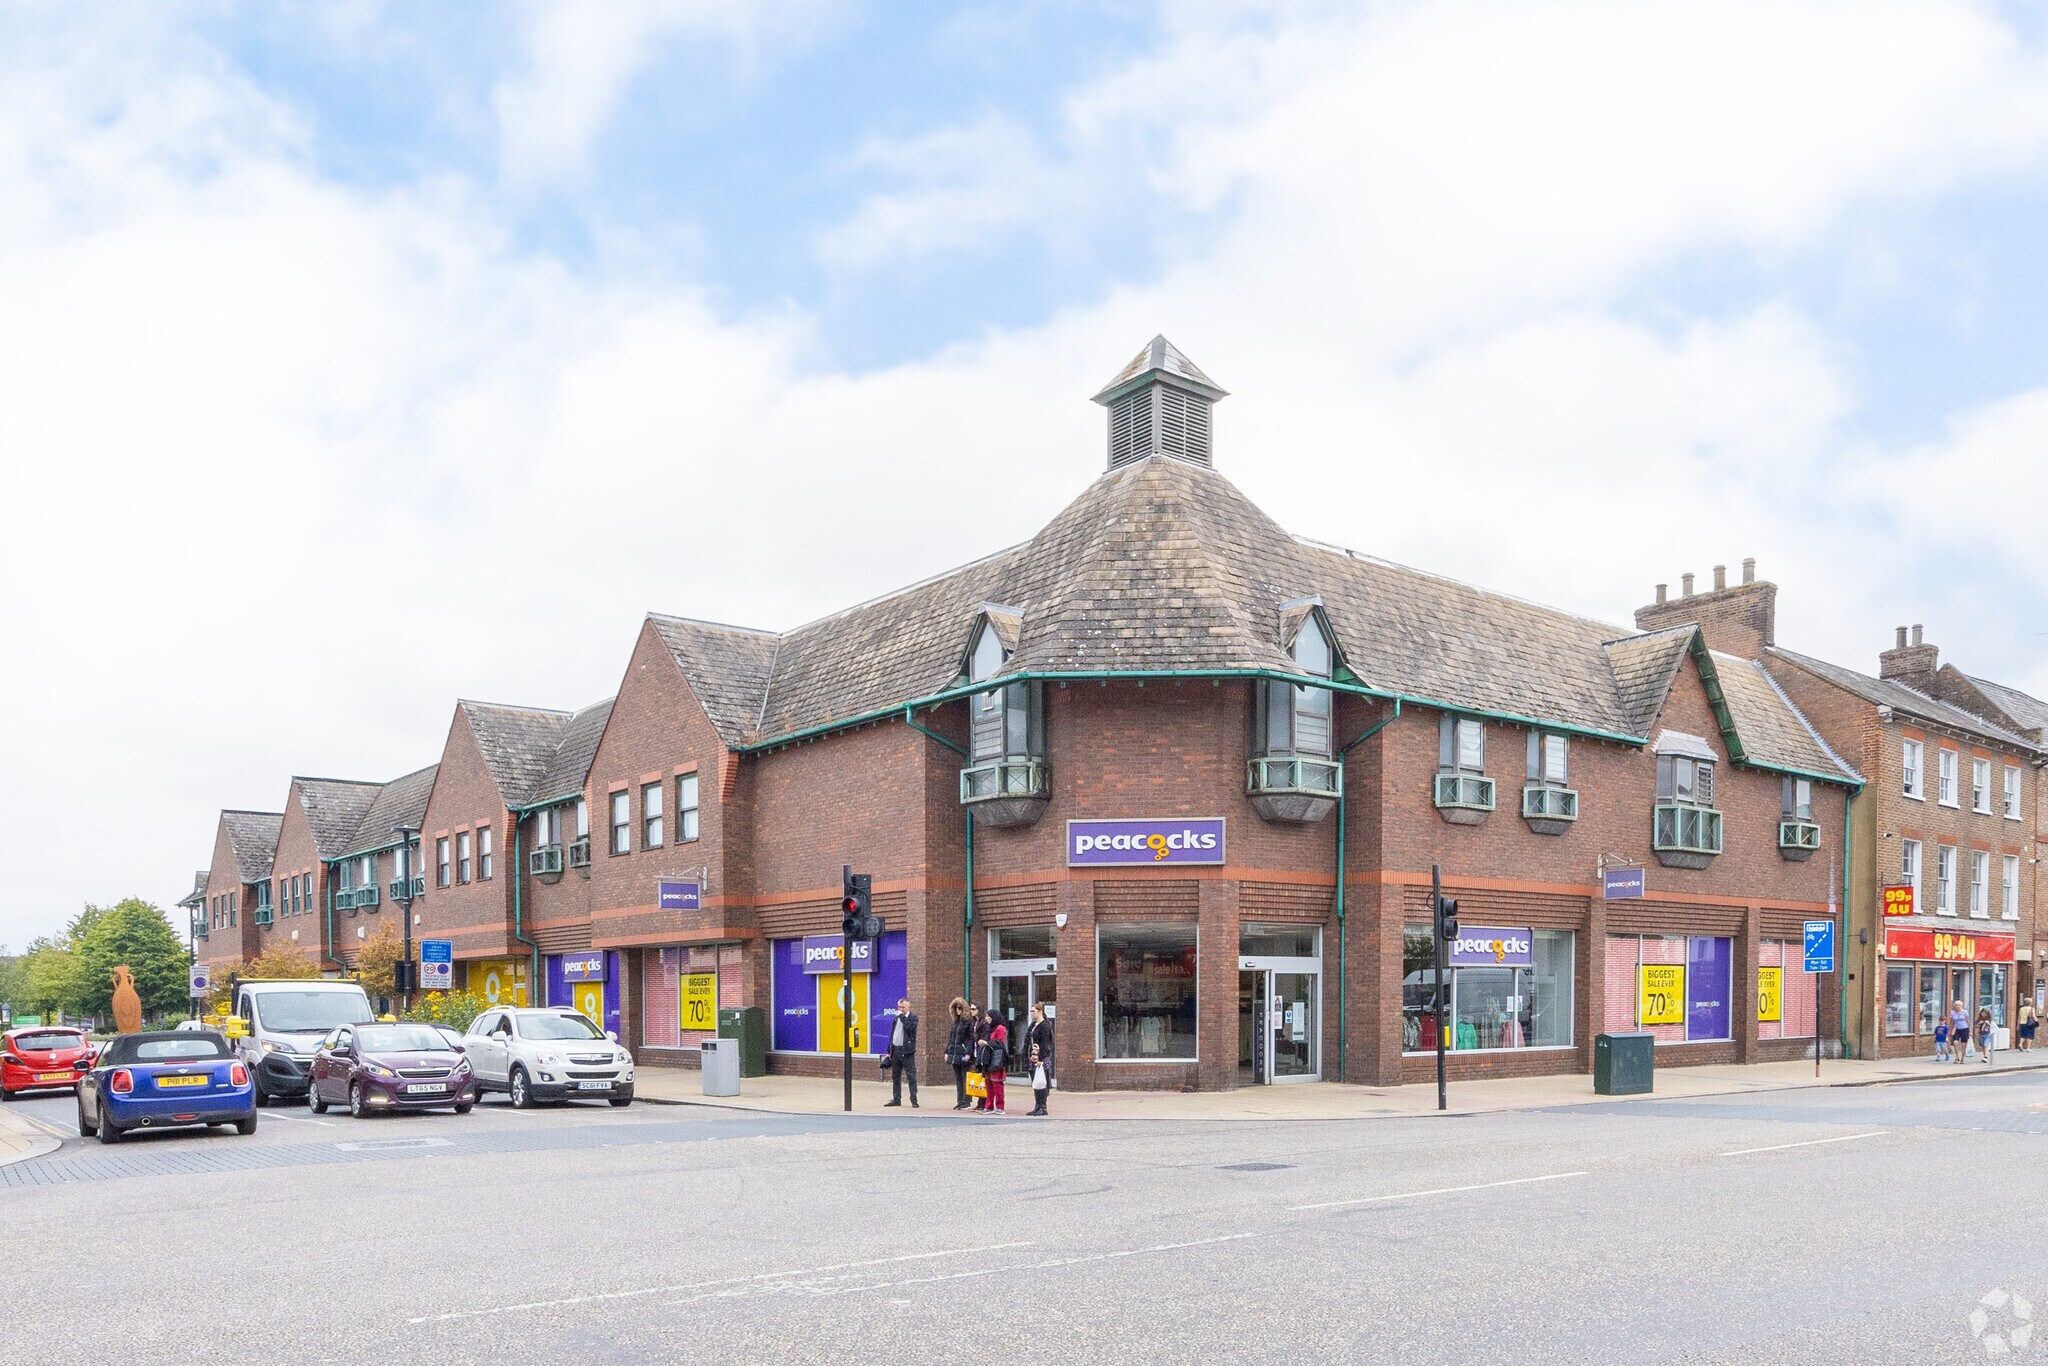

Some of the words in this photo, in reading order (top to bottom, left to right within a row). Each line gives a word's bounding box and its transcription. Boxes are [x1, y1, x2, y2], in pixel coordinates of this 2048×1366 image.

[1076, 830, 1216, 858] peacocks
[1607, 880, 1640, 888] peacocks
[663, 893, 697, 901] peacocks
[1885, 890, 1912, 902] 99p
[1888, 903, 1909, 914] 4U
[1453, 937, 1529, 961] peacocks
[806, 942, 868, 966] peacoks
[565, 958, 601, 977] peacocks
[1648, 970, 1675, 979] BIGGEST
[1758, 971, 1775, 980] GGEST
[688, 977, 710, 986] BIGGEST
[1696, 1000, 1719, 1008] peacocks
[784, 1008, 808, 1017] peacocks
